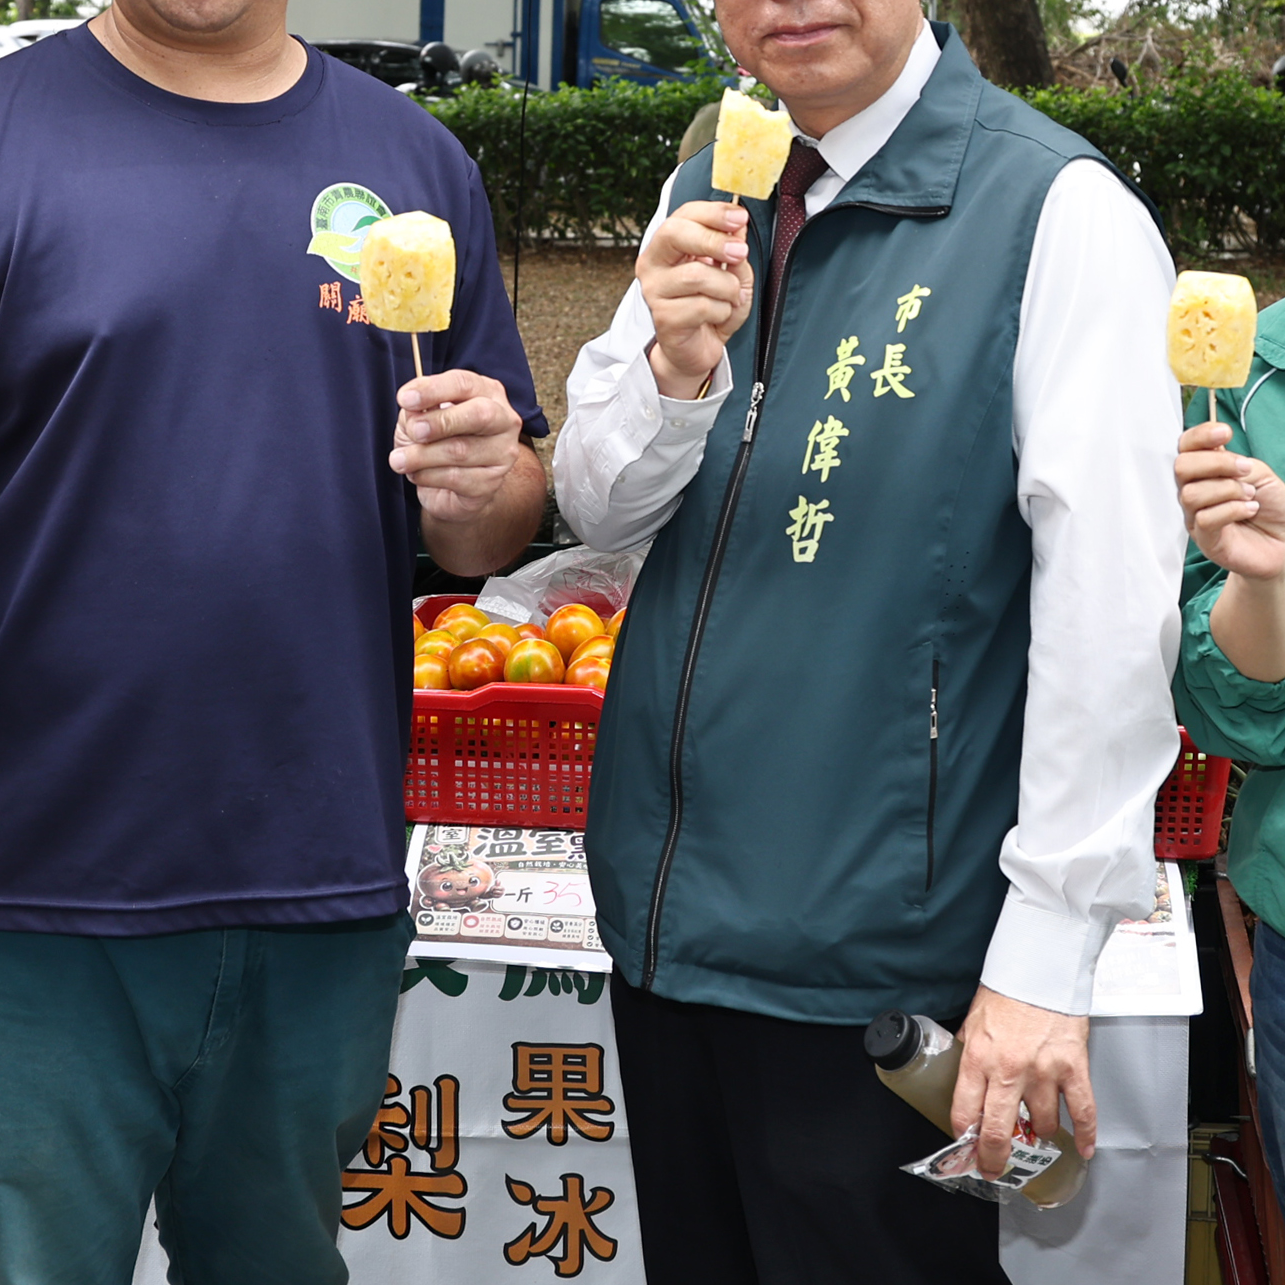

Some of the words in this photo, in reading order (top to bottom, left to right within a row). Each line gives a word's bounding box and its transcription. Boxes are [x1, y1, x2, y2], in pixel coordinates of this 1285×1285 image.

[870, 284, 932, 399] 市長
[785, 335, 866, 564] 黃偉哲
[543, 881, 586, 907] 35
[502, 1042, 618, 1278] 果冰
